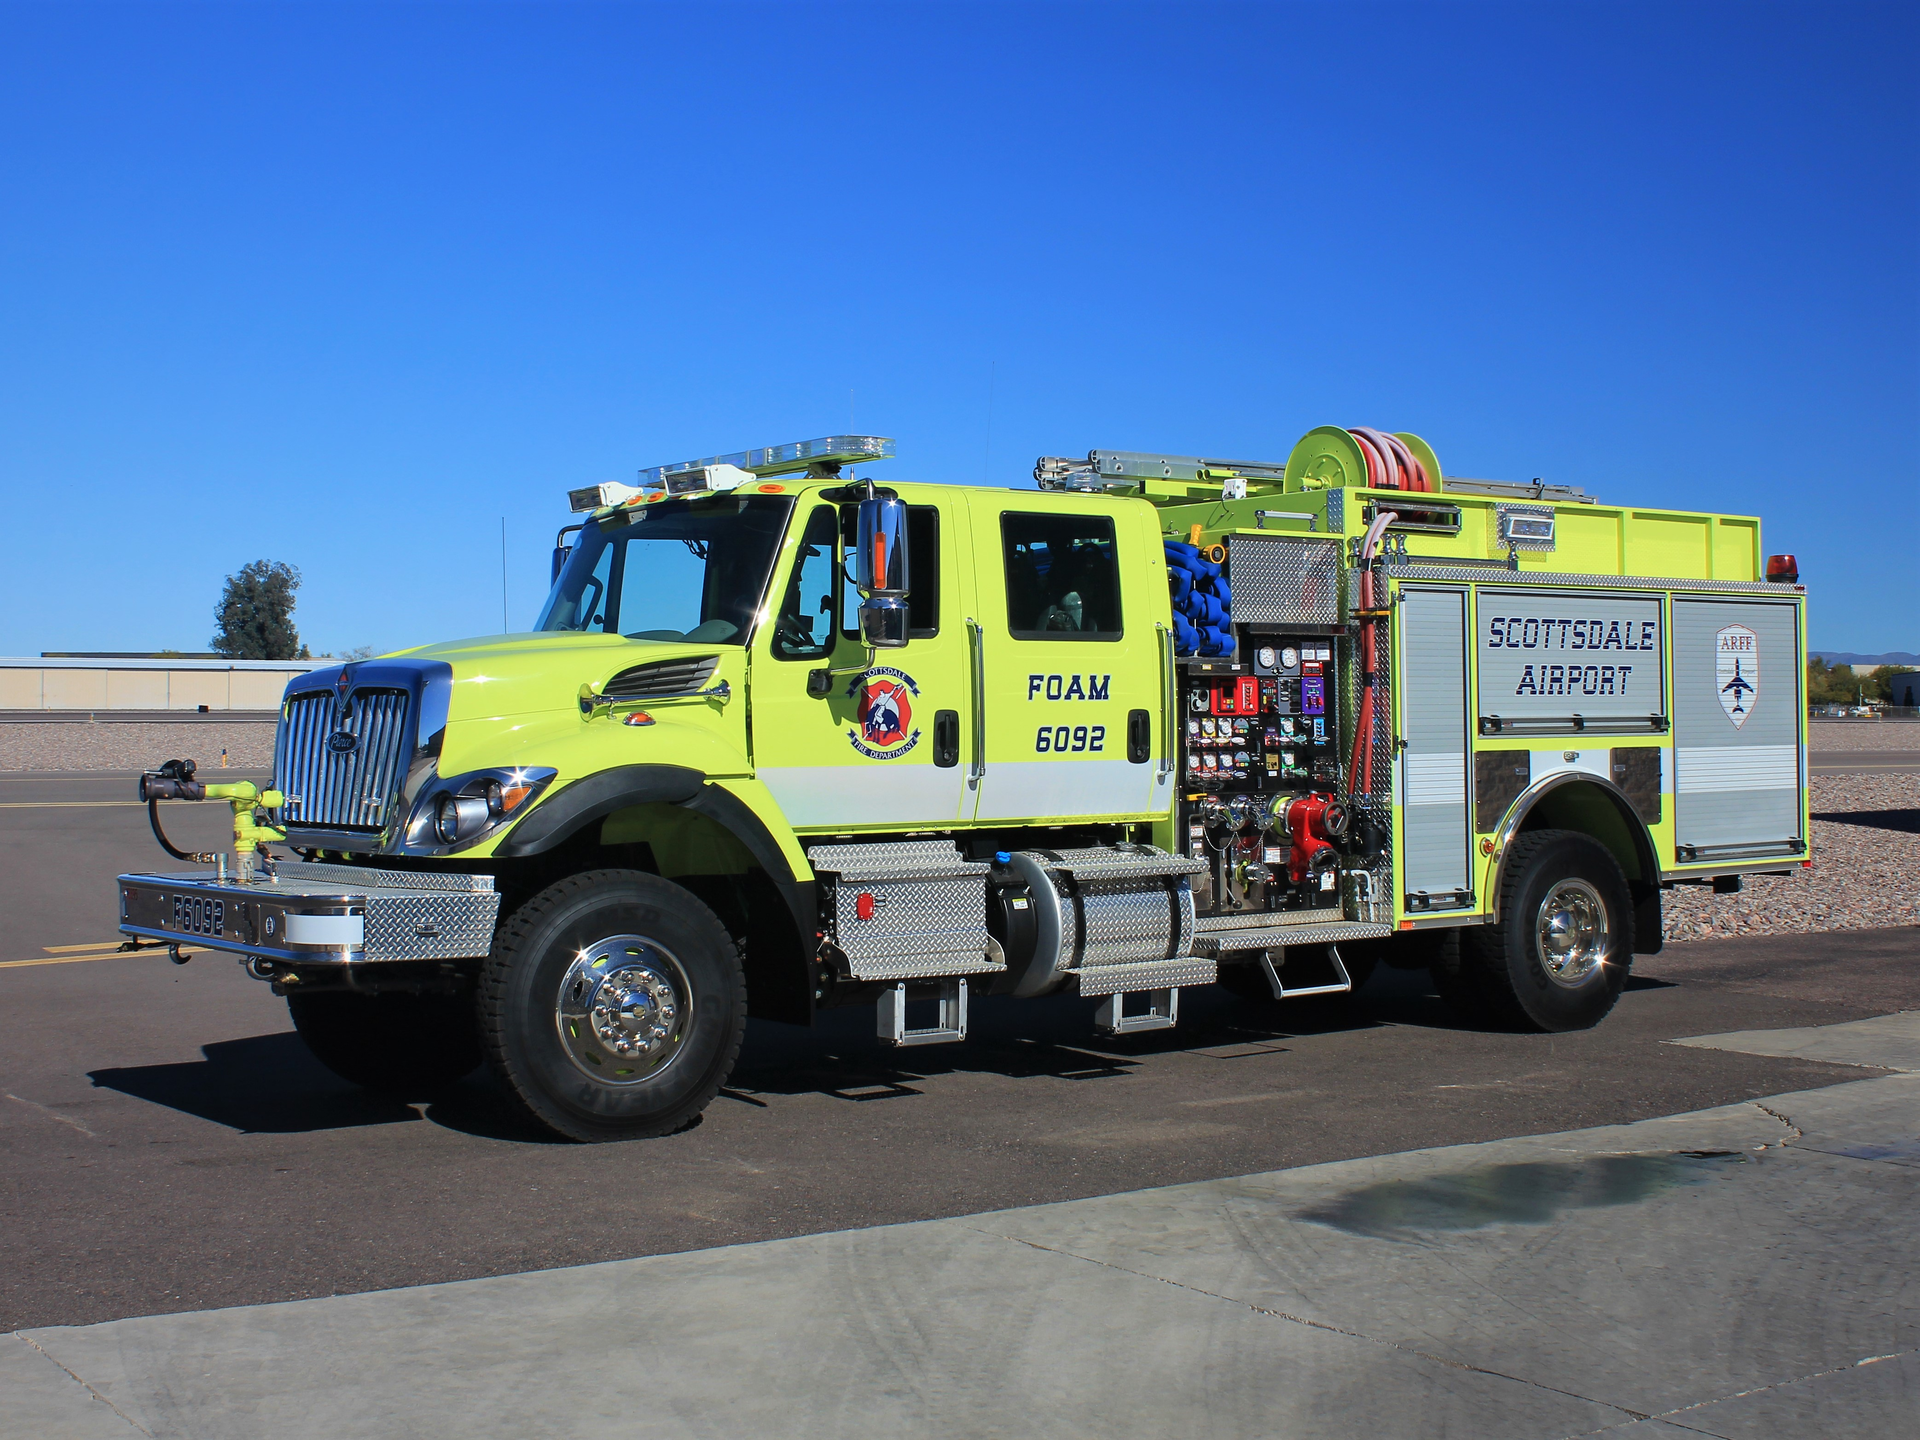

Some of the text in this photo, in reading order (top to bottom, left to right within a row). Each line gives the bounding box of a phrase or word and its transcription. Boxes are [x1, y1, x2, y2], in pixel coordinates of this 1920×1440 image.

[1488, 616, 1656, 651] SCOTTSDALE
[1721, 635, 1752, 650] ARFF
[860, 667, 906, 681] SCOTTSDALE
[1028, 674, 1110, 700] FOAM
[1515, 664, 1633, 696] AIRPORT
[331, 733, 352, 748] Pierce
[854, 739, 915, 759] FIRE DEPARTMENT
[1035, 725, 1105, 752] 6092
[172, 894, 225, 937] F6092
